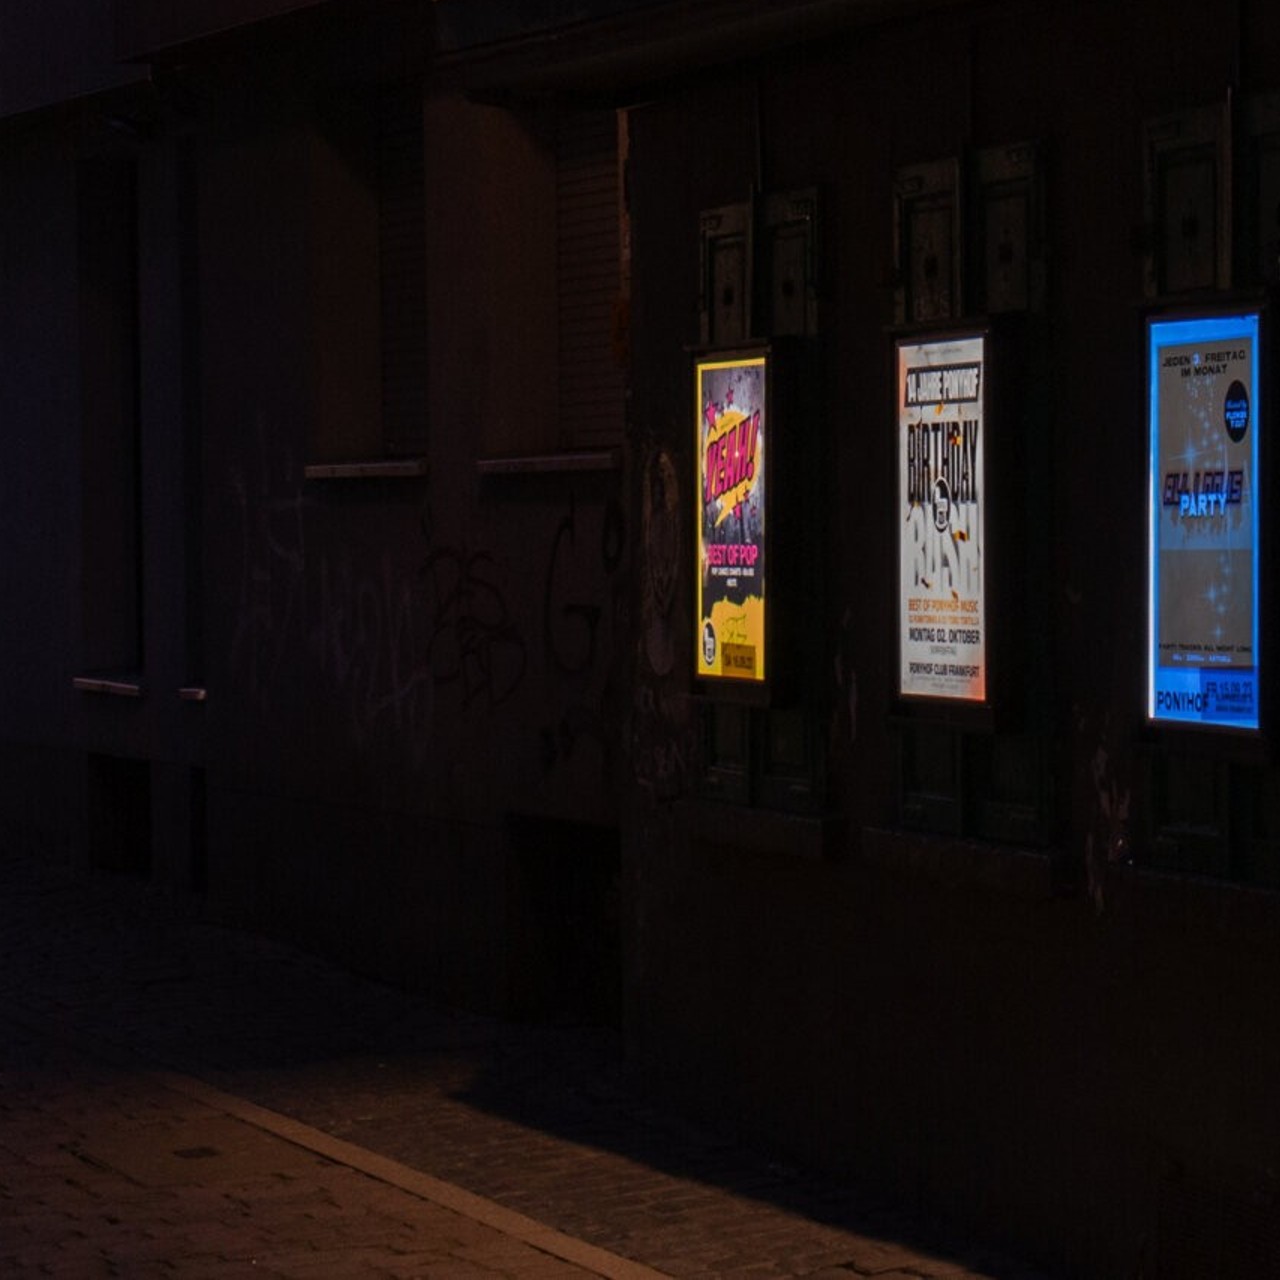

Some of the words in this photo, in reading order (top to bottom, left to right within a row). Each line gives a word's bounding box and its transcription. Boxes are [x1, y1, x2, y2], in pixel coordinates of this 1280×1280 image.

[1205, 350, 1246, 363] FREITAG
[1181, 366, 1191, 377] IM
[1194, 363, 1228, 377] MONAT
[705, 409, 761, 505] YEAH!
[907, 420, 979, 505] BIRTHDAY
[1179, 492, 1228, 518] PARTY
[708, 543, 726, 566] BEST
[727, 543, 739, 566] OF
[740, 543, 759, 567] POP
[909, 627, 935, 642] MONTAG
[948, 628, 980, 645] OKTOBER
